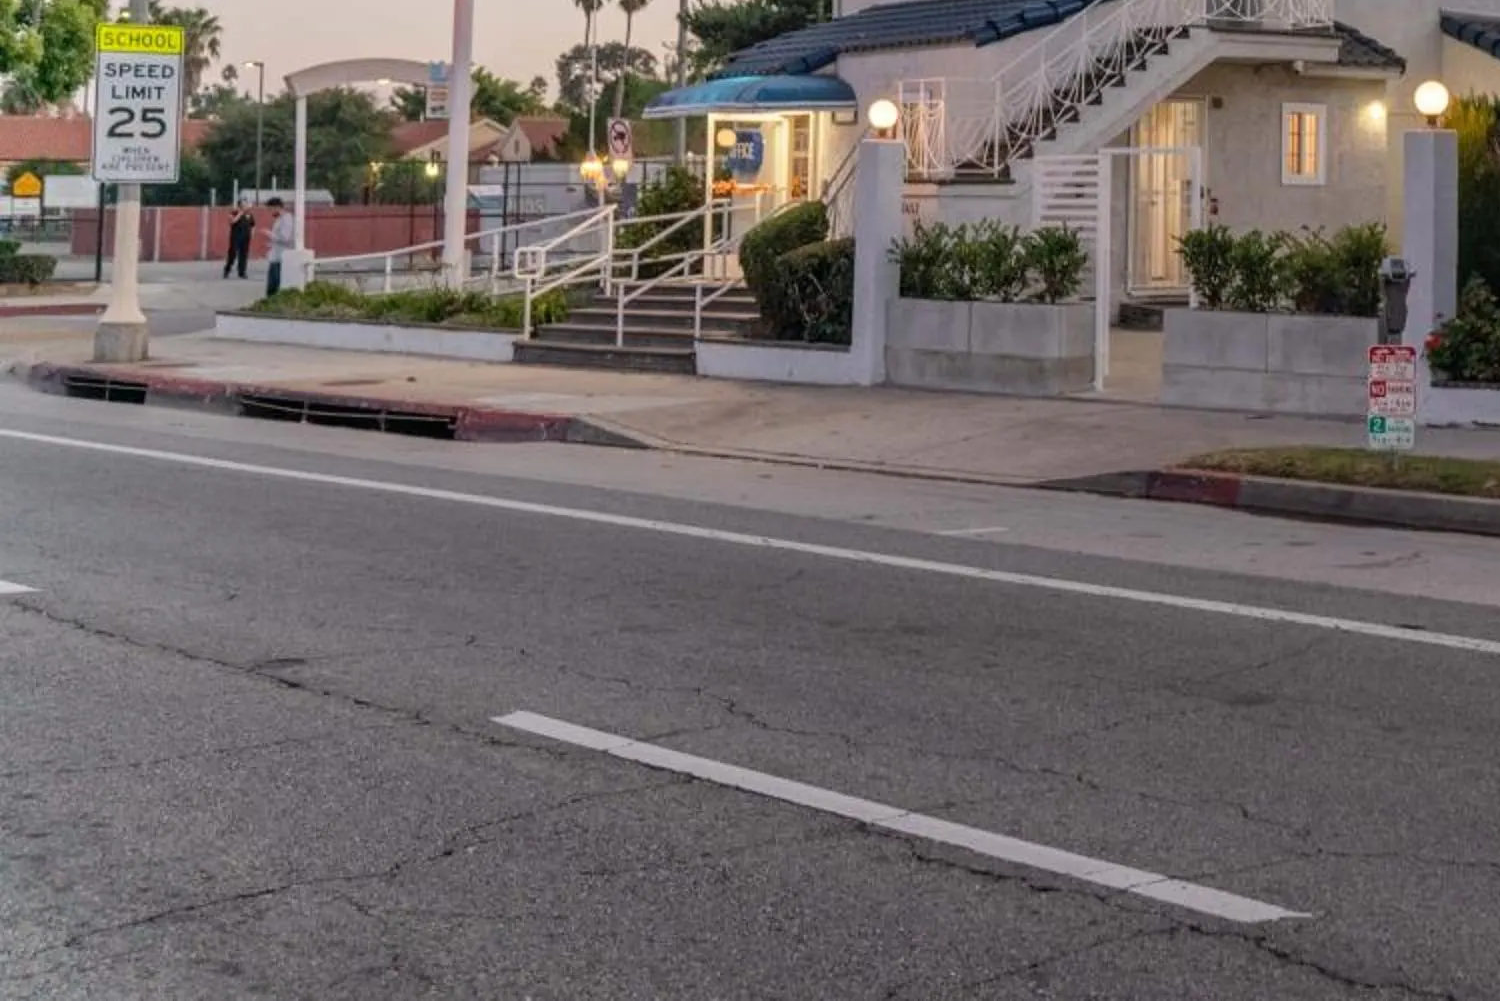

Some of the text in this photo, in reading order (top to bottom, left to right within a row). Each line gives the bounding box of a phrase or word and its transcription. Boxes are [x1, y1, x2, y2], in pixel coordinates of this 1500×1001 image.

[103, 31, 177, 49] SCHOOL
[104, 62, 175, 79] SPEED
[111, 84, 165, 100] LIMIT
[106, 106, 167, 138] 25
[1372, 419, 1383, 432] 2
